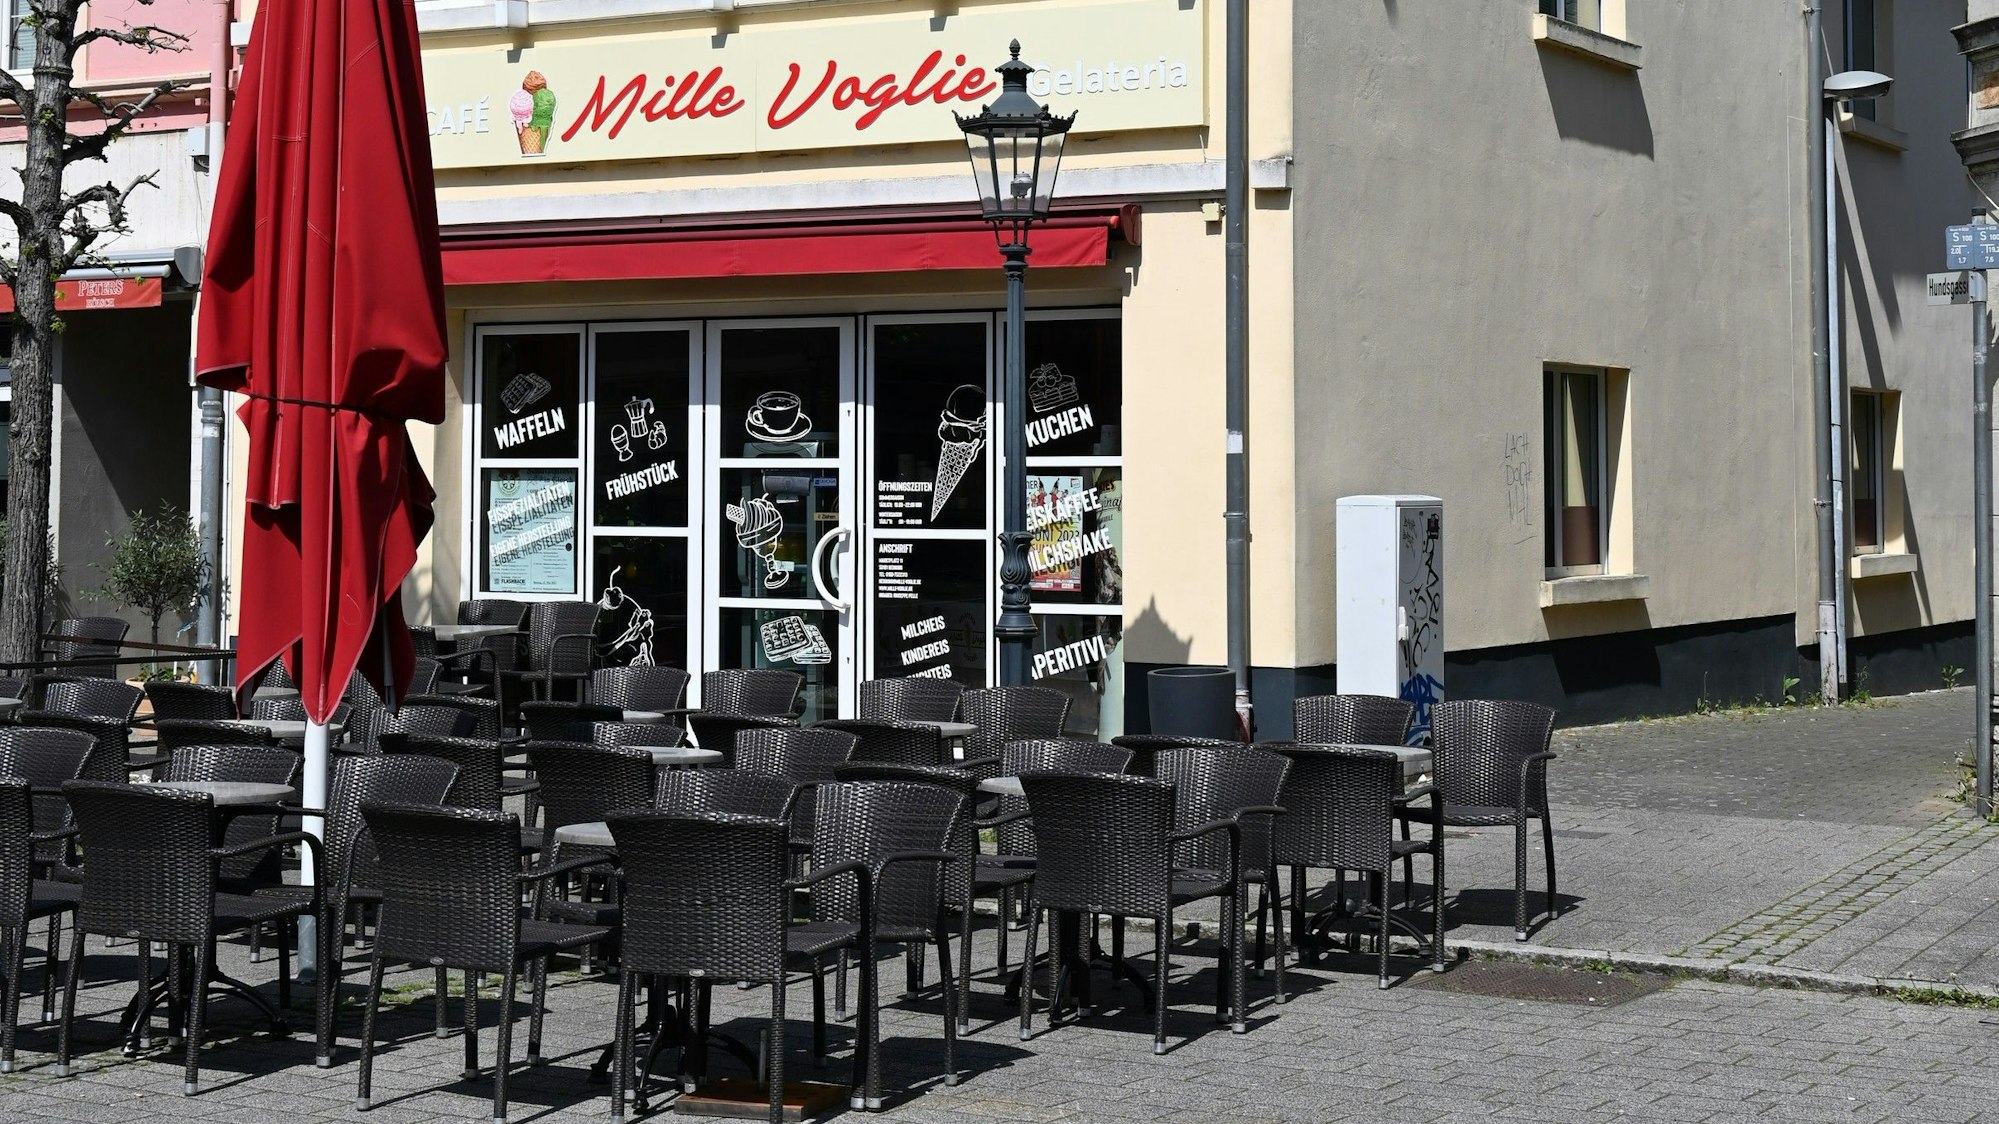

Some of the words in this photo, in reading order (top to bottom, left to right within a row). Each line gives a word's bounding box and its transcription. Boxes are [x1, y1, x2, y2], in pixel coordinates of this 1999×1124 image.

[561, 66, 745, 142] Mille
[767, 50, 997, 130] Voglie
[1027, 55, 1188, 97] Gelateria
[493, 407, 566, 450] WAFFELN
[1025, 404, 1094, 448] KUCHEN
[605, 460, 679, 500] FRÜHSTÜCK
[878, 480, 933, 492] ÖFFNUNGSZEITEN
[1027, 487, 1102, 531] EISKAFFEE
[879, 543, 914, 553] ANSCHRIFT
[1028, 528, 1114, 573] ILCHSHAKE
[900, 615, 946, 640] MILCHEIS
[901, 639, 950, 666] KINDEREIS
